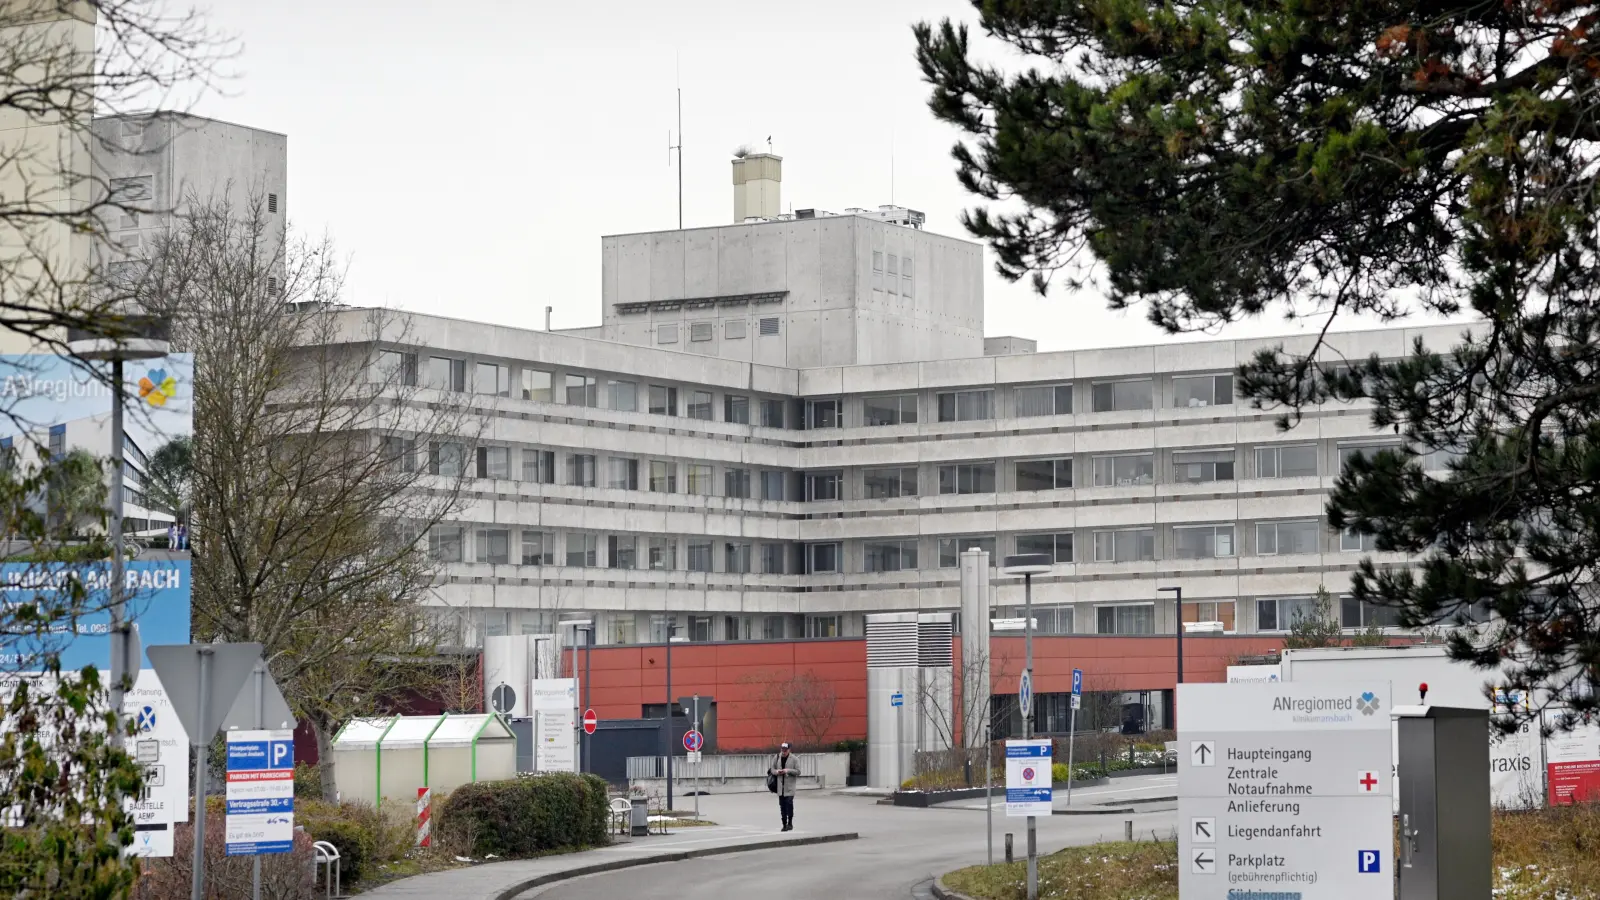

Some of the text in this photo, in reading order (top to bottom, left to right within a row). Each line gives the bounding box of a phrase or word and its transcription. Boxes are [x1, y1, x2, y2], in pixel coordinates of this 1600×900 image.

[84, 569, 180, 590] ANBACH
[1273, 696, 1352, 713] ANregiomed
[1292, 714, 1353, 723] klinikumansbach
[274, 743, 287, 766] P
[1228, 747, 1312, 762] Haupteingang
[1490, 753, 1531, 773] raxis
[1228, 767, 1278, 779] Zentrale
[1228, 782, 1312, 795] Notaufnahme
[129, 802, 164, 810] BAUSTELLE
[229, 799, 269, 809] Vertragsstrafe
[1228, 800, 1300, 815] Anlieferung
[138, 812, 155, 820] AEMP
[1228, 825, 1321, 840] Liegendanfahrt
[1228, 854, 1285, 868] Parkplatz
[1363, 851, 1376, 872] P
[1228, 872, 1318, 885] (gebührenpflichtig)
